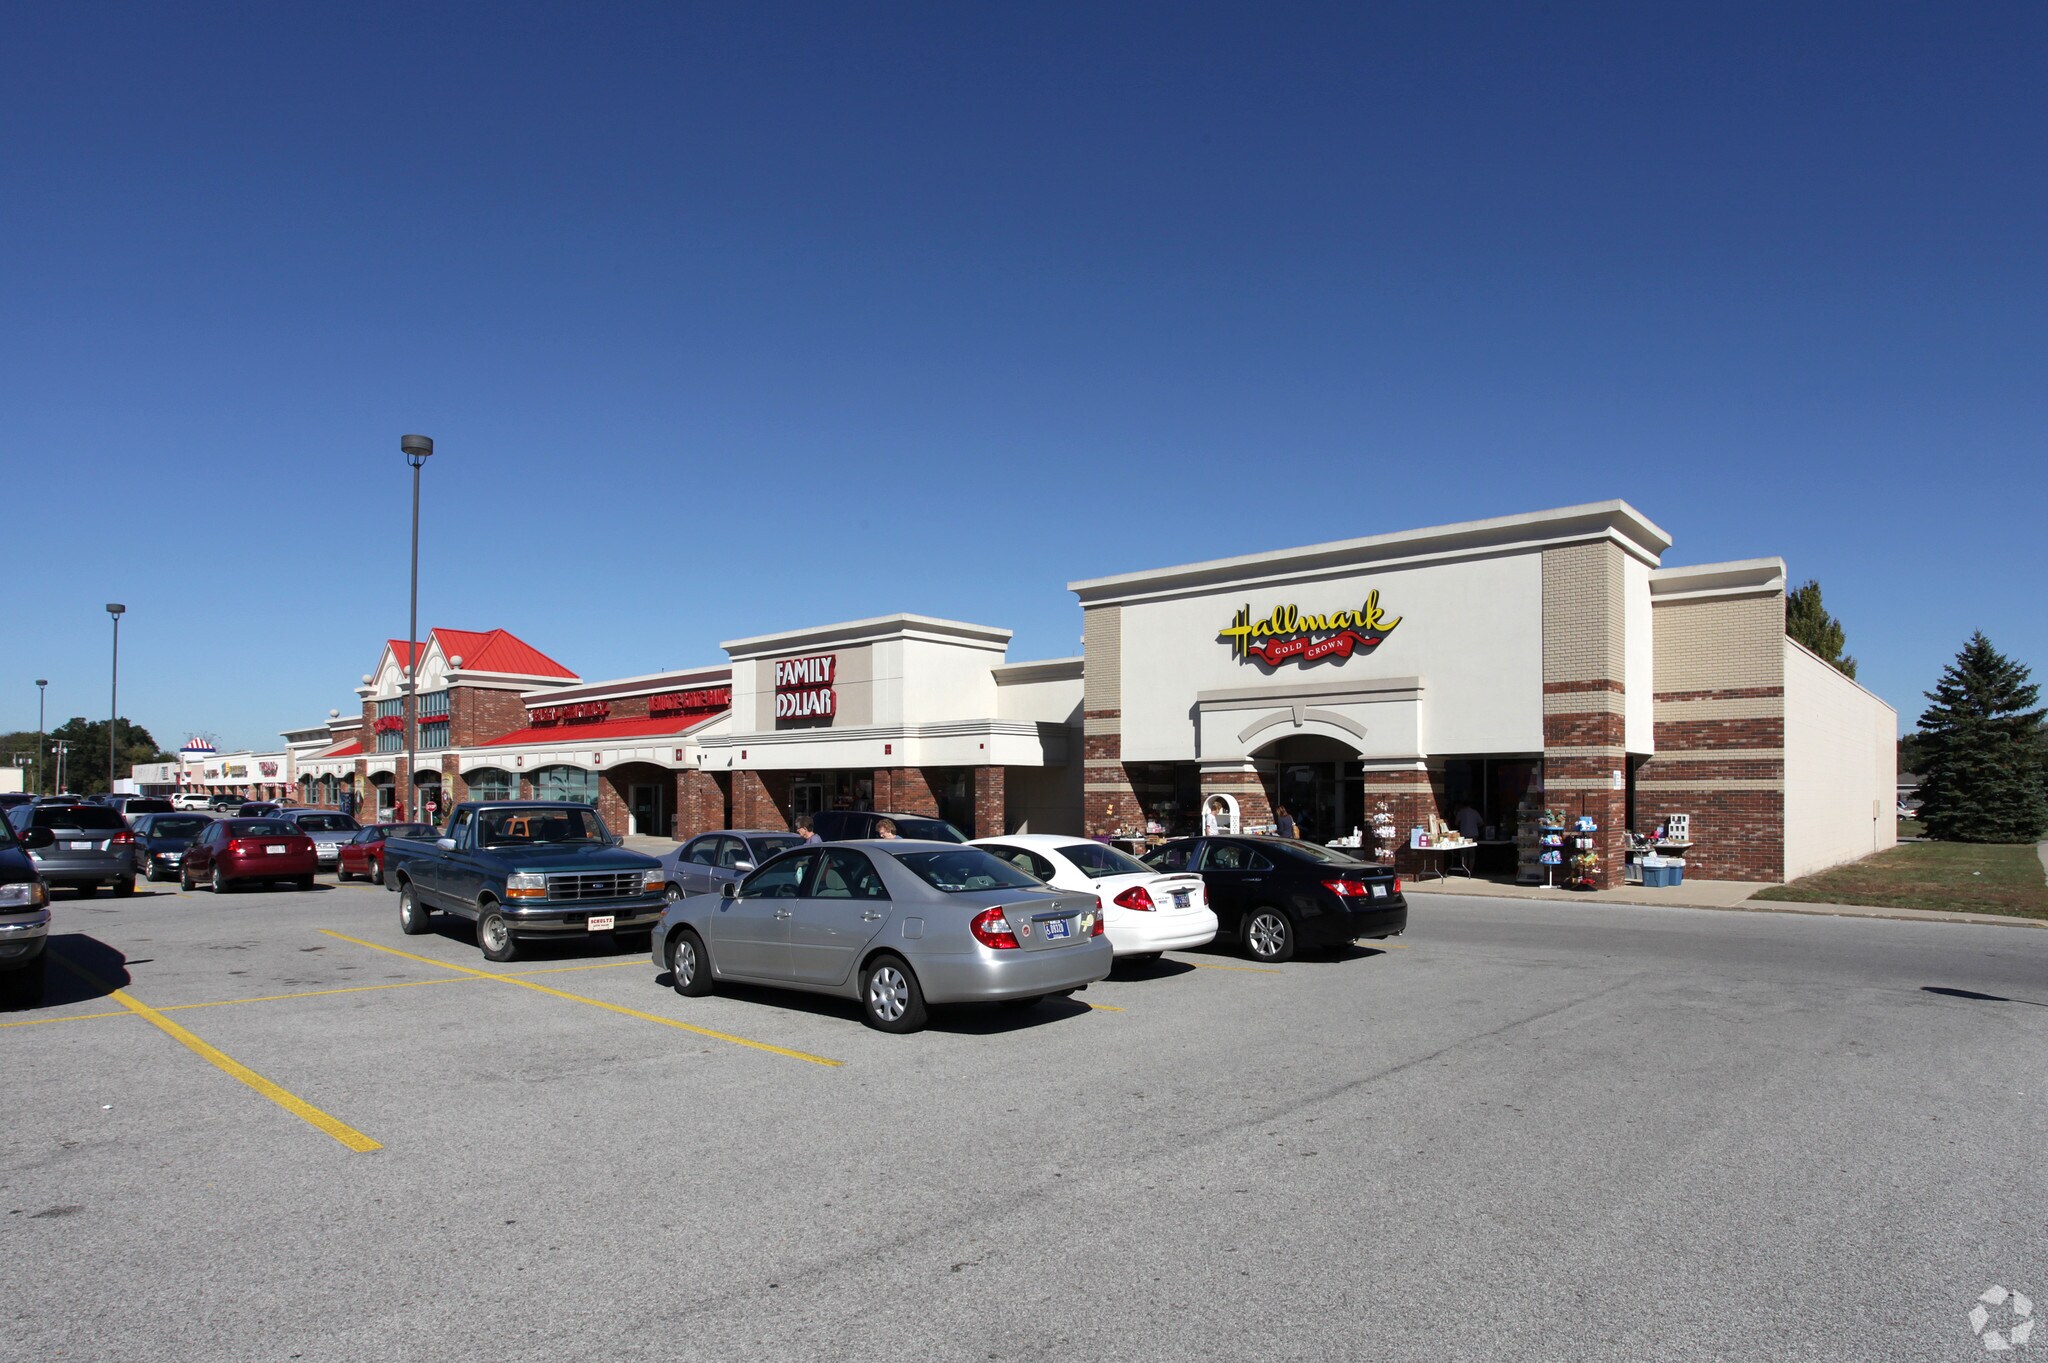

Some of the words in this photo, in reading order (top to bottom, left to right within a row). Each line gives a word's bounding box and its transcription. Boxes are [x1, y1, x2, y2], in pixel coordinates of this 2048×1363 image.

[1219, 589, 1400, 657] Hallmark
[1275, 642, 1302, 655] GOLD
[1308, 640, 1343, 656] CROWN
[776, 656, 833, 686] FAMILY
[776, 688, 832, 717] DOLLAR
